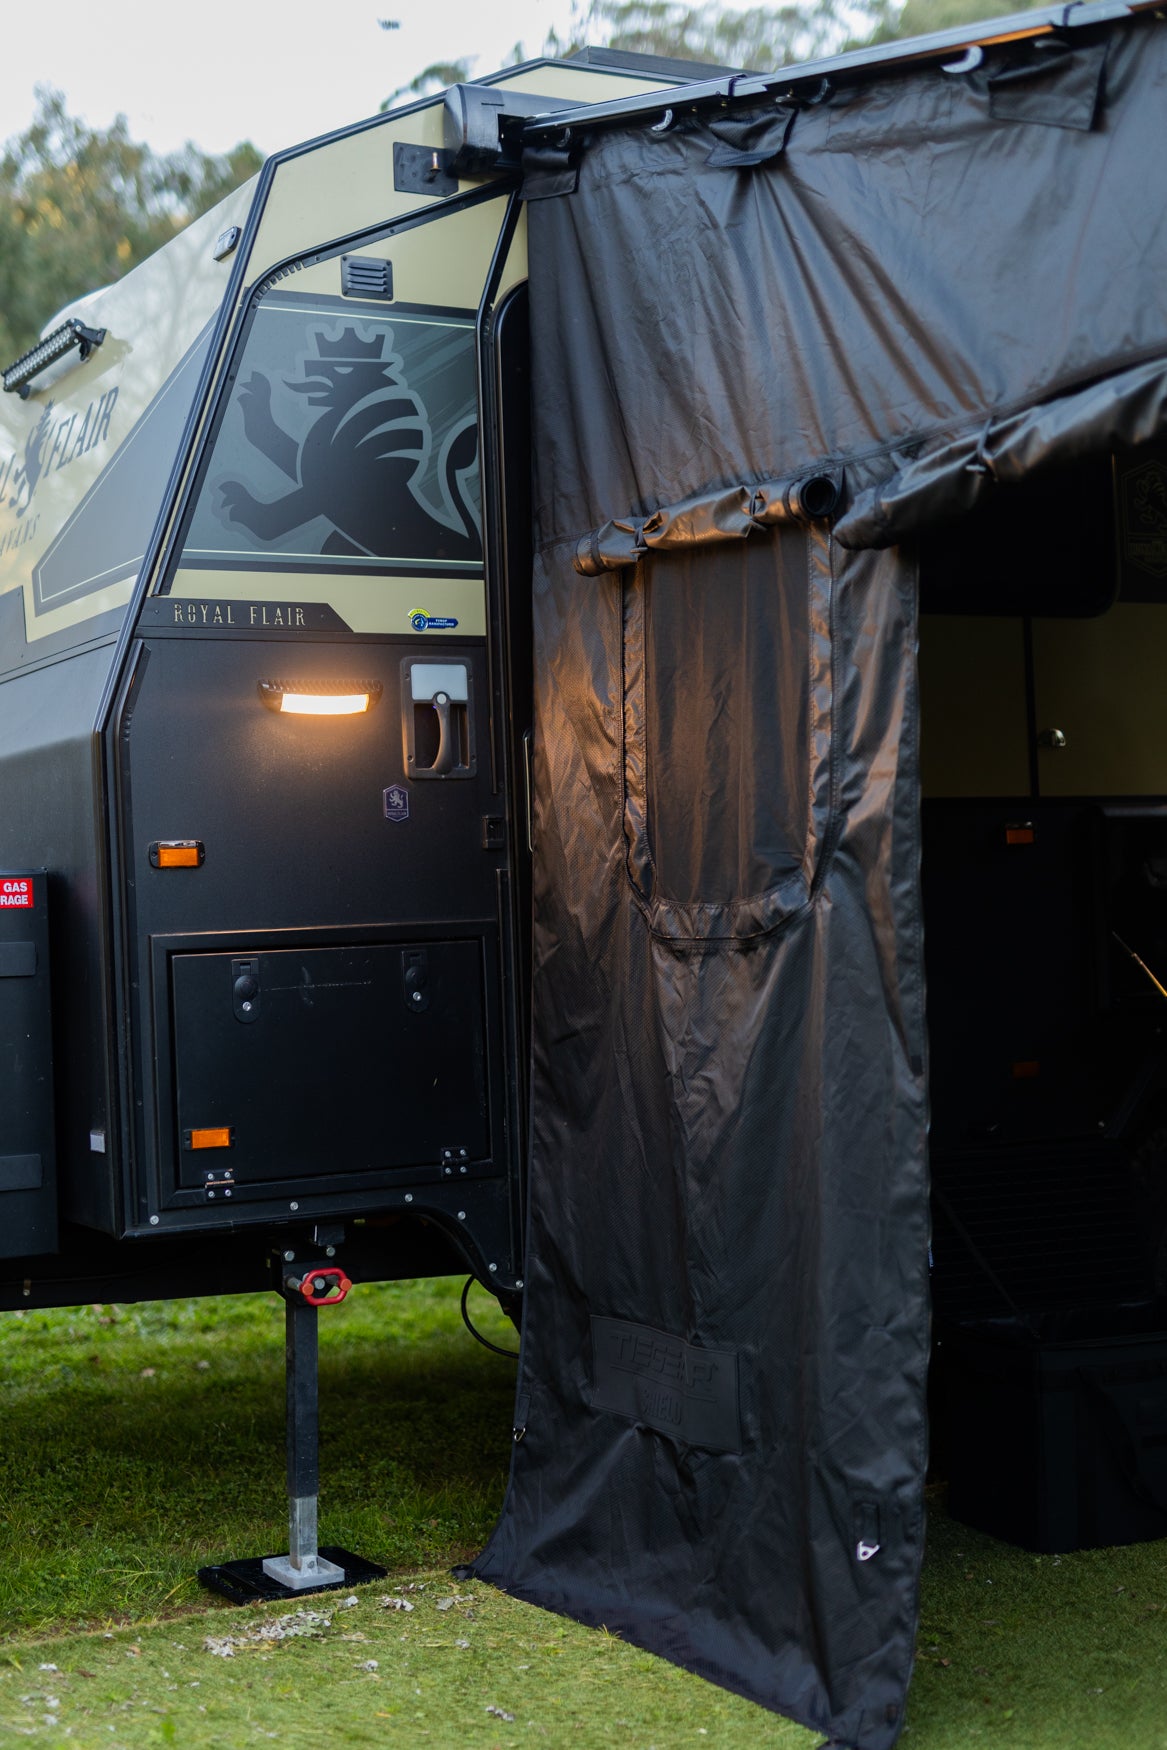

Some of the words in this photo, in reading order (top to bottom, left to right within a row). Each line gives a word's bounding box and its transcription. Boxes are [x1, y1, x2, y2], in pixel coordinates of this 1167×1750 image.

[43, 386, 119, 479] FLAIR
[174, 604, 235, 623] ROYAL
[249, 606, 306, 626] FLAIR
[3, 882, 28, 892] GAS
